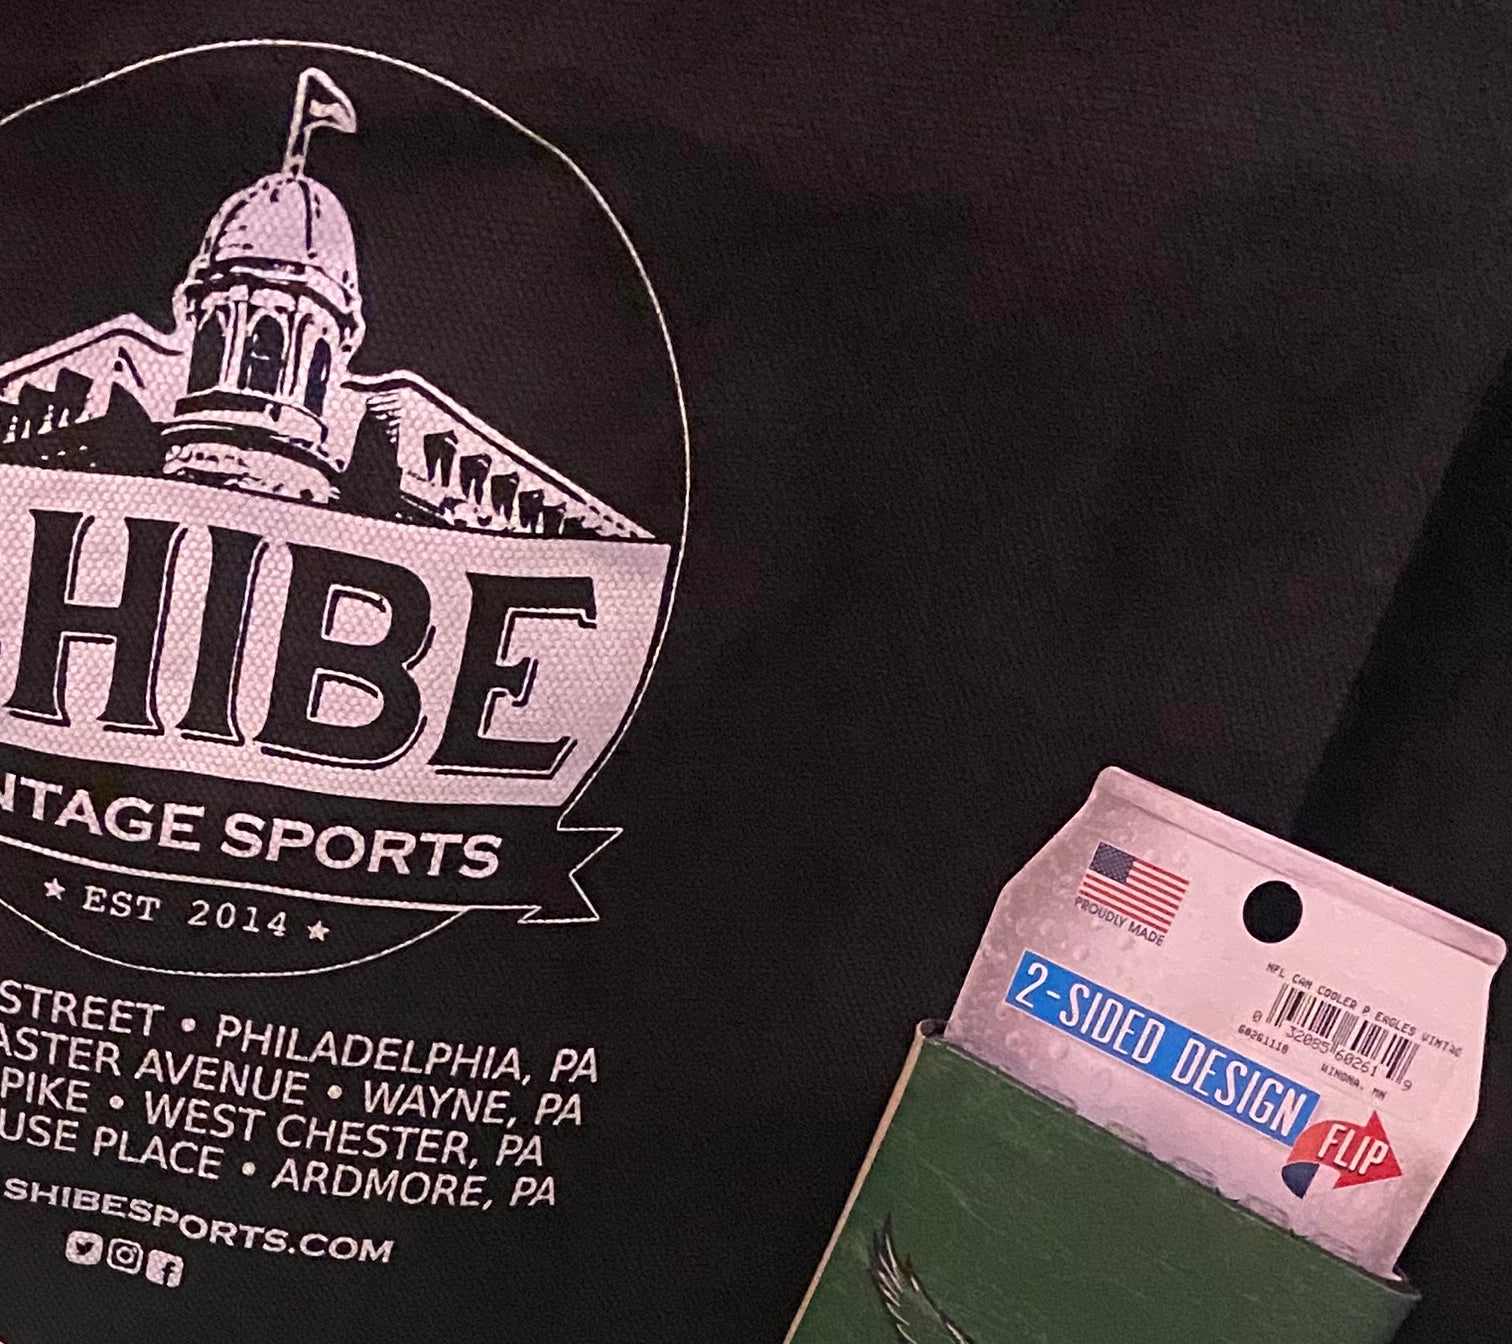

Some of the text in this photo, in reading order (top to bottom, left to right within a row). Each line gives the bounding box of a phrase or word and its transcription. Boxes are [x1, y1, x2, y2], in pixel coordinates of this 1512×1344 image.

[221, 810, 504, 880] SPORTS
[82, 884, 288, 939] EST 2014
[1074, 896, 1165, 947] PROUDLY MADE
[1317, 984, 1358, 1012] COOLER
[1374, 1010, 1418, 1037] EAGLES
[215, 1014, 531, 1086] PHILADELPHIA,
[550, 1047, 598, 1083] PA
[1014, 961, 1308, 1138] 2-SIDED DESIGN
[1251, 1010, 1413, 1092] 0 32085 60261 9
[0, 1066, 90, 1113] PIKE
[144, 1090, 266, 1142] WEST
[276, 1114, 479, 1170] CHESTER,
[495, 1135, 545, 1167] PA
[134, 1048, 310, 1105] AVENUE
[363, 1079, 518, 1129] WAYNE,
[534, 1093, 584, 1127] PA
[93, 1126, 225, 1181] PLACE
[271, 1158, 493, 1210] ARDMORE,
[509, 1176, 556, 1207] PA
[1317, 1123, 1390, 1176] FLIP
